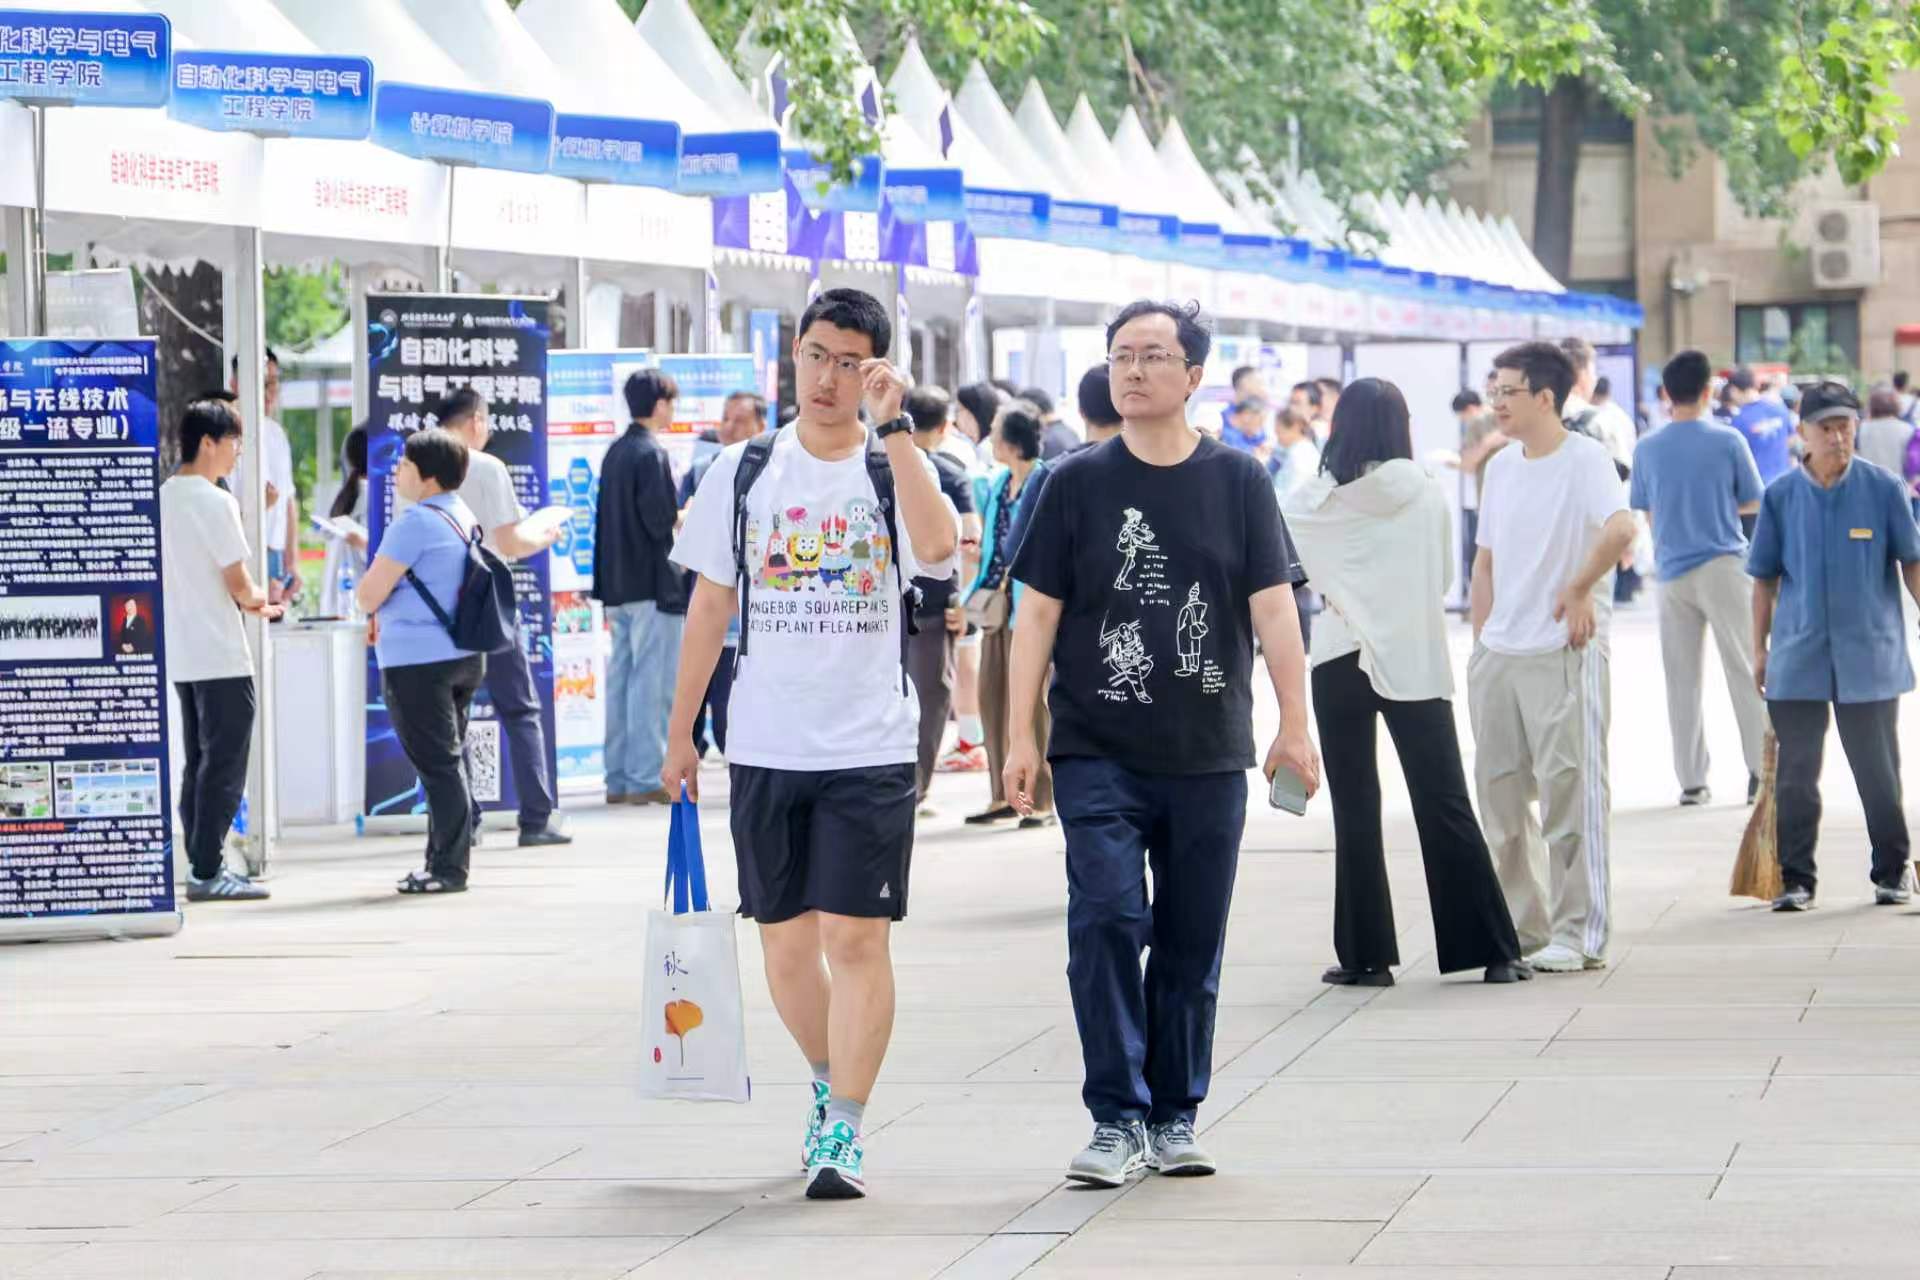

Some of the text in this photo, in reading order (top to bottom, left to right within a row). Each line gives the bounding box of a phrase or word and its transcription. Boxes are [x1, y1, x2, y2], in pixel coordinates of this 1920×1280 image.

[0, 27, 157, 57] 化科学与电气
[0, 60, 103, 88] 工程学院
[176, 63, 362, 97] 自动化科学与电气
[223, 96, 314, 121] 工程学院
[411, 111, 514, 144] 计算机学院
[552, 134, 644, 162] 算机学院
[401, 338, 518, 366] 自动化科学
[775, 620, 814, 634] PLANT
[819, 620, 853, 634] FLEA
